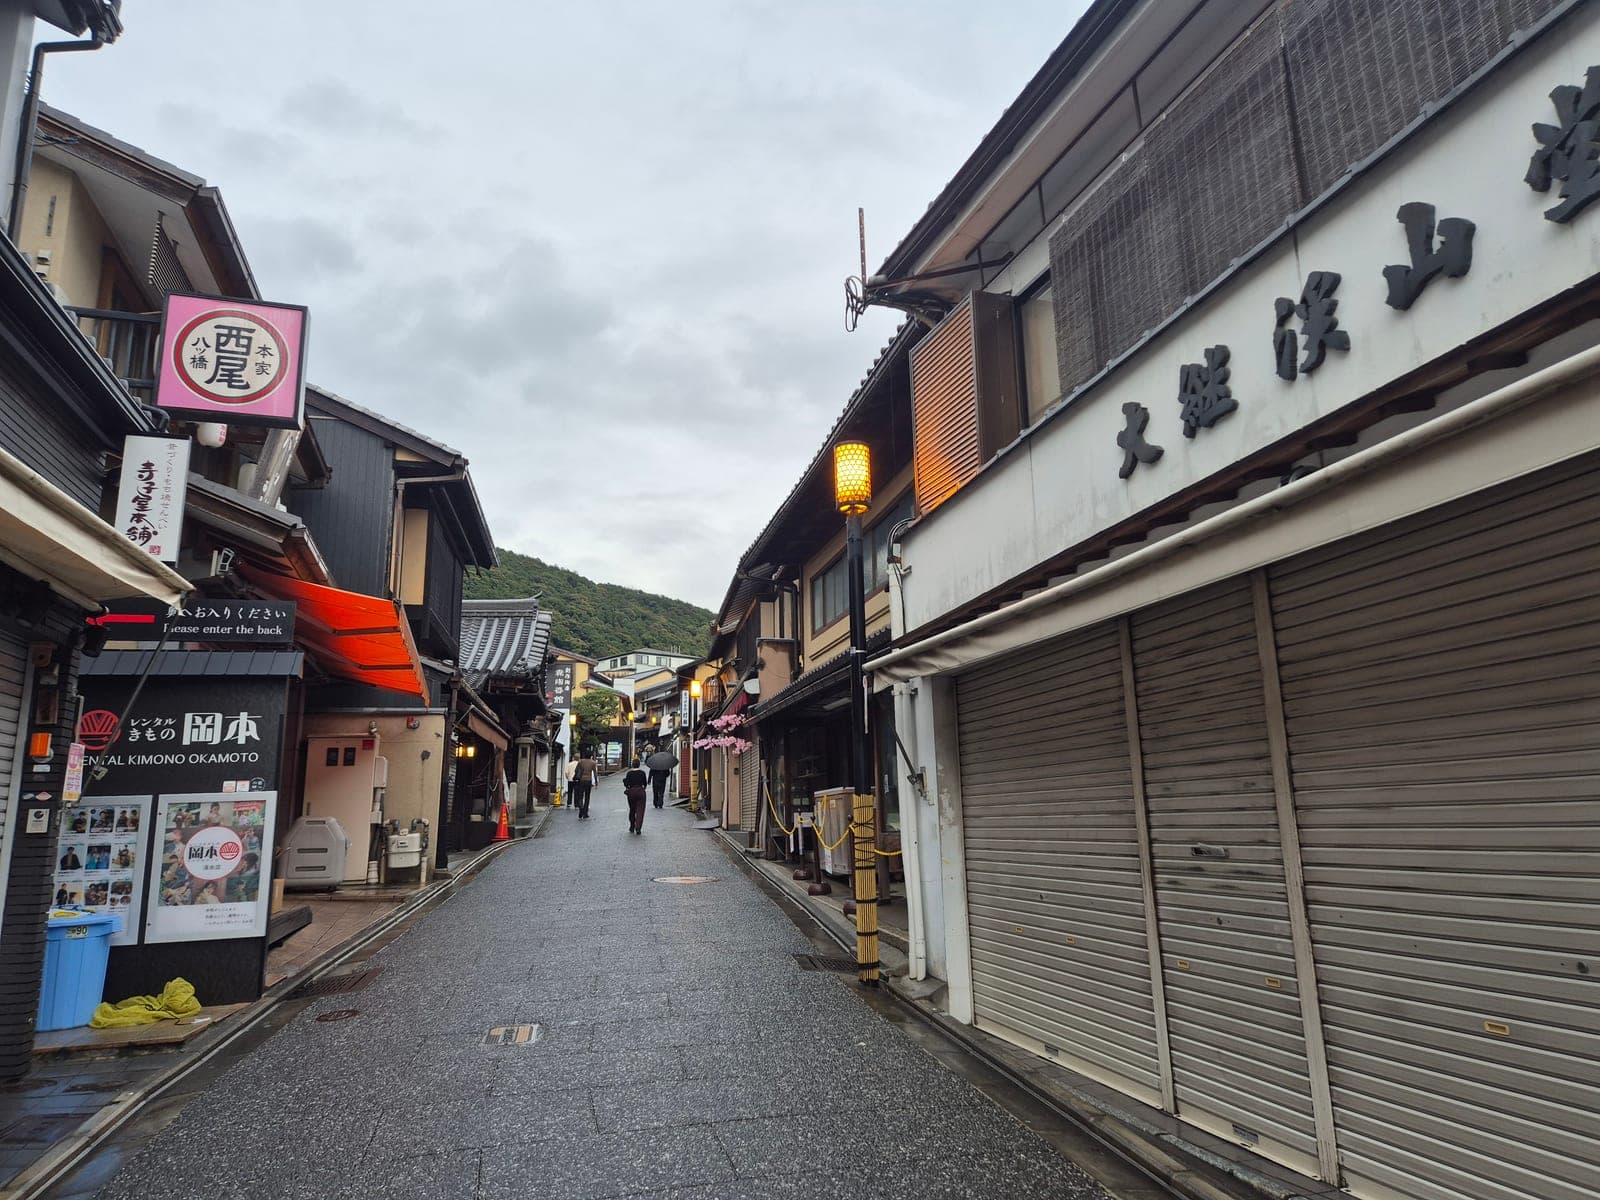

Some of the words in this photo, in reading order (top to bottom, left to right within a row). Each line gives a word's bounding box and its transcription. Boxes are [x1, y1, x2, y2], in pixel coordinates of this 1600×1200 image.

[204, 324, 257, 391] 西尾
[255, 344, 274, 376] 本家
[202, 625, 233, 634] enter
[236, 624, 255, 635] the
[257, 625, 283, 636] back
[130, 716, 177, 728] レンタル
[182, 711, 263, 746] 岡本
[128, 727, 176, 742] きもの
[81, 754, 125, 767] ENTAL
[127, 753, 186, 766] KIMONO
[188, 751, 260, 764] OKAMOTO
[188, 845, 219, 860] 岡本
